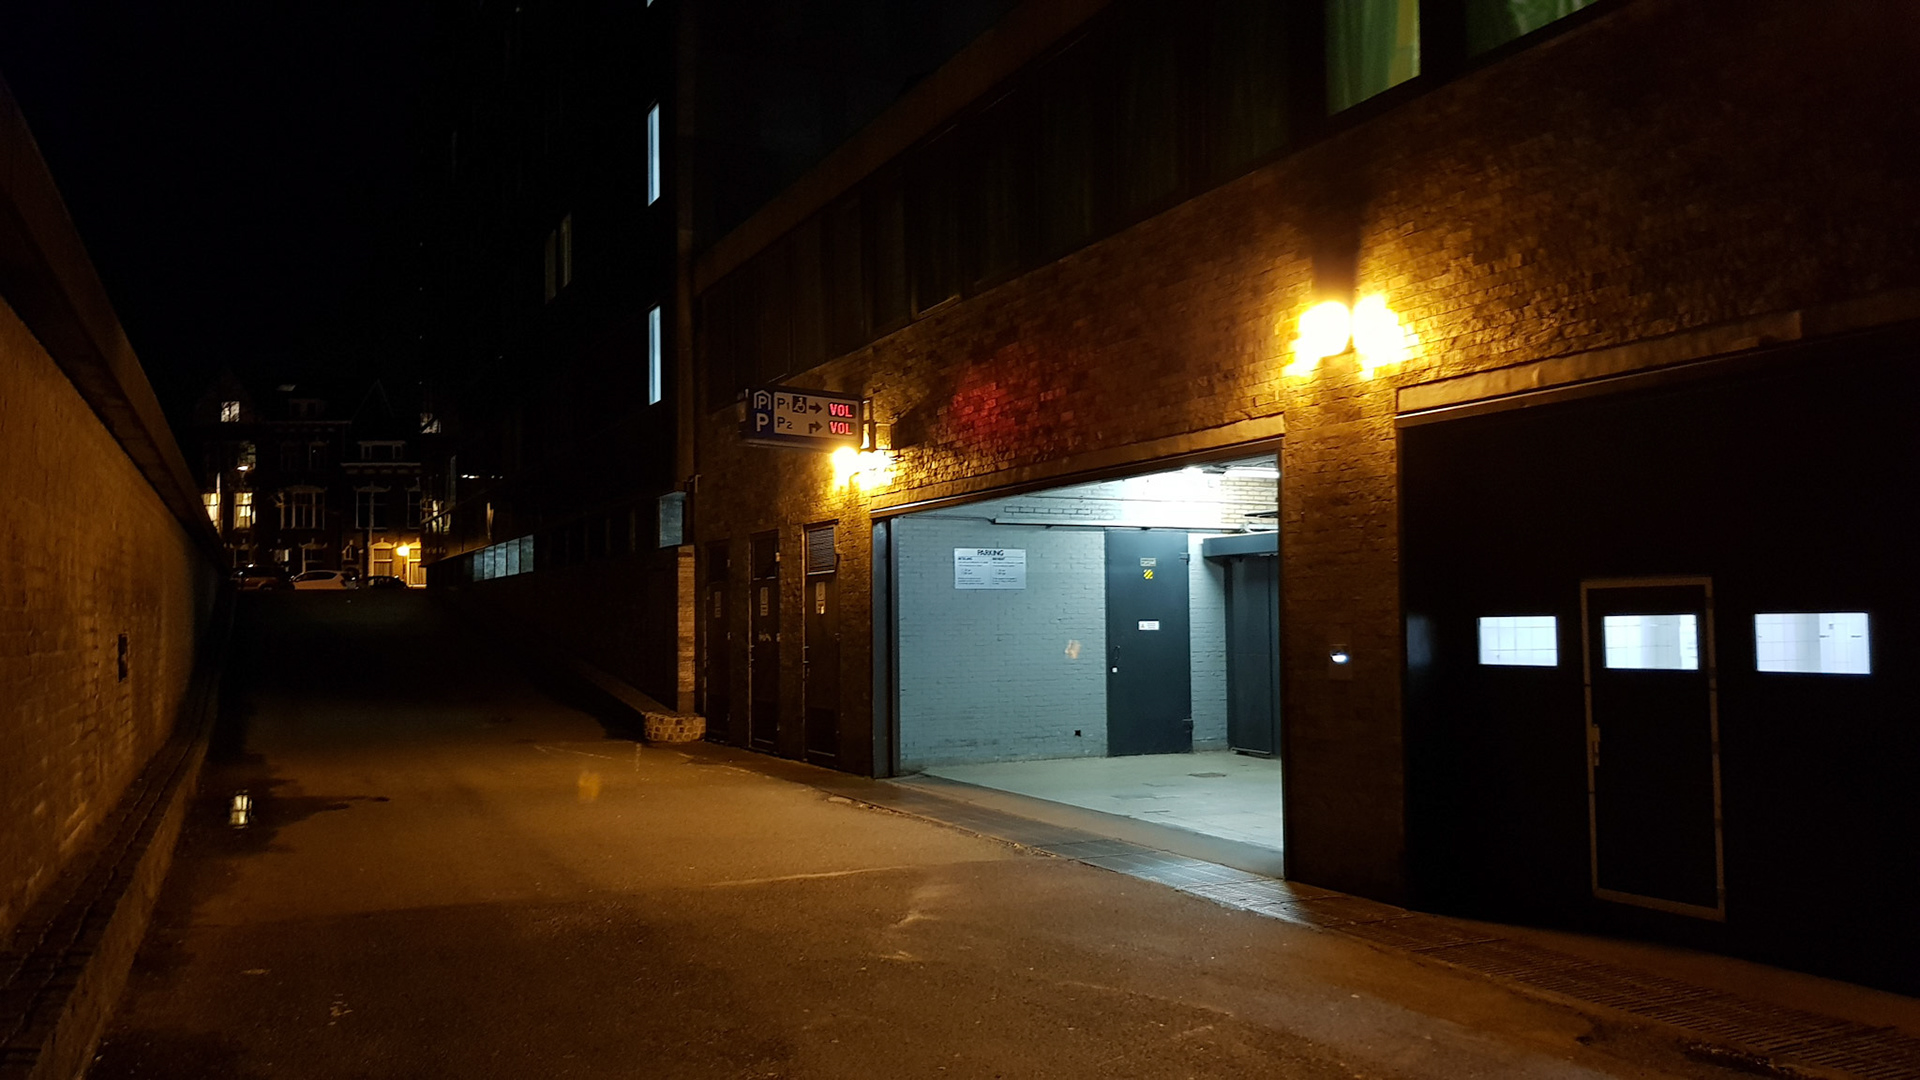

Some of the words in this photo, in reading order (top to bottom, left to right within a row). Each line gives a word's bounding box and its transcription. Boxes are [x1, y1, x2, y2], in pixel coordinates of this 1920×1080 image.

[758, 396, 767, 409] P
[777, 398, 790, 410] P1
[830, 403, 853, 417] VOL
[756, 413, 769, 432] P
[777, 417, 793, 429] P2
[830, 421, 853, 435] VOL
